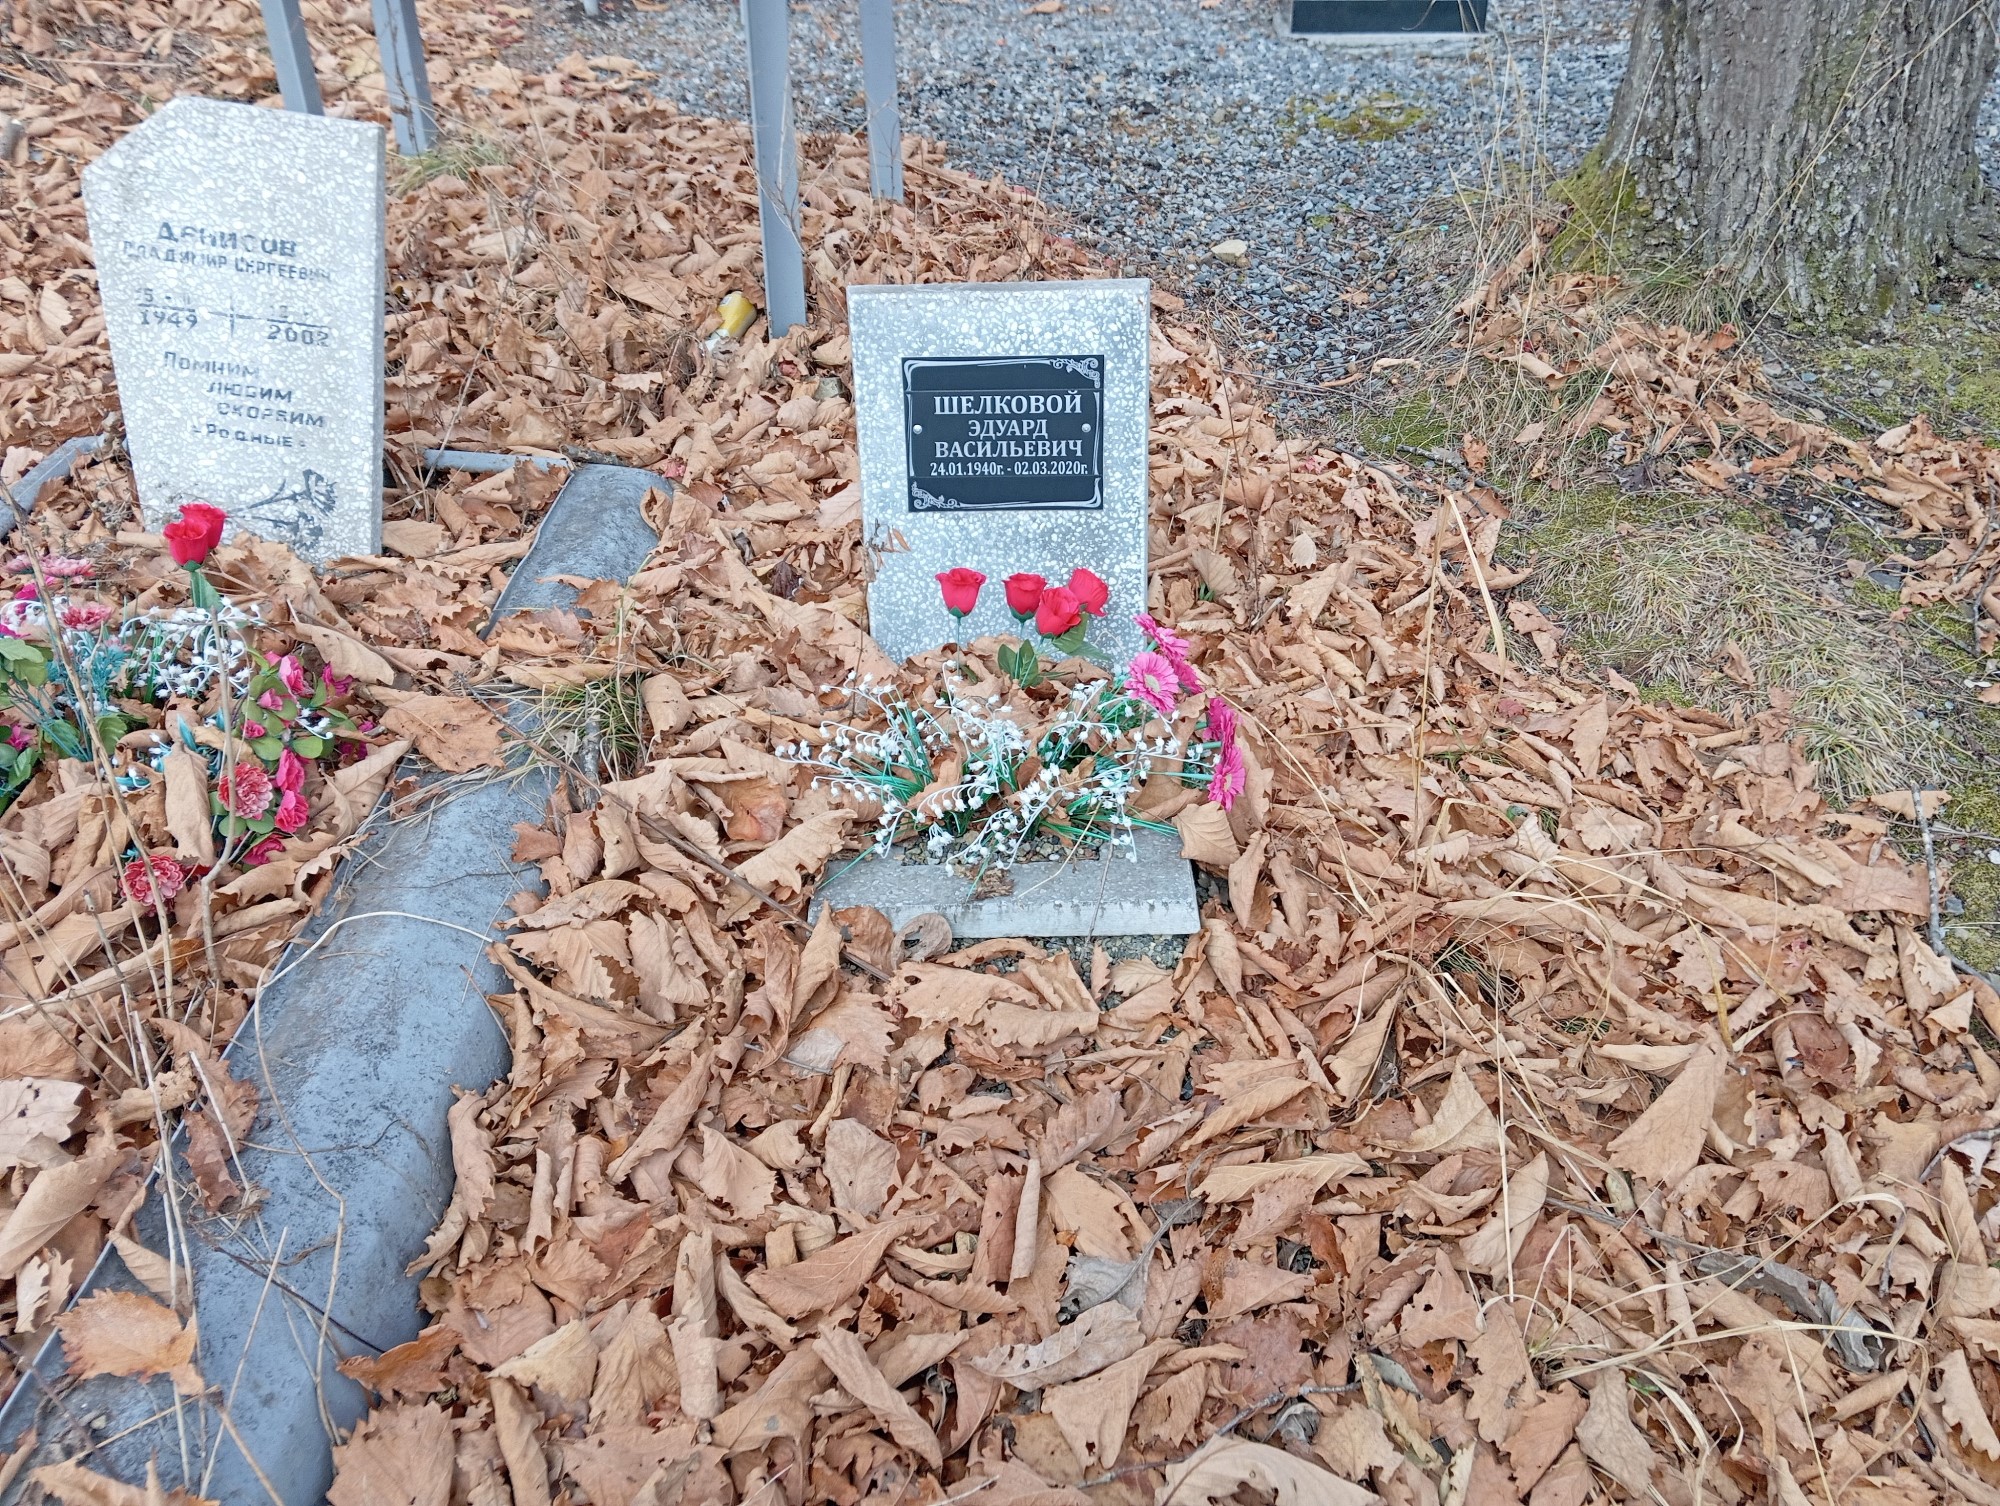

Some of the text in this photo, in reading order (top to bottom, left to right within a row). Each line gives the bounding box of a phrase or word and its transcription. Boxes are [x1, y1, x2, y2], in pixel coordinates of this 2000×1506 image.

[140, 308, 198, 332] 1949
[267, 324, 329, 347] 2002
[933, 389, 1082, 415] ШЕЛКОВОЙ
[968, 419, 1049, 440] ЭДУАРД
[934, 439, 1083, 458] ВАСИЛЬЕВИЧ
[930, 461, 1005, 476] 24.01.1940г.
[1014, 460, 1088, 475] 02.03.2020г.
